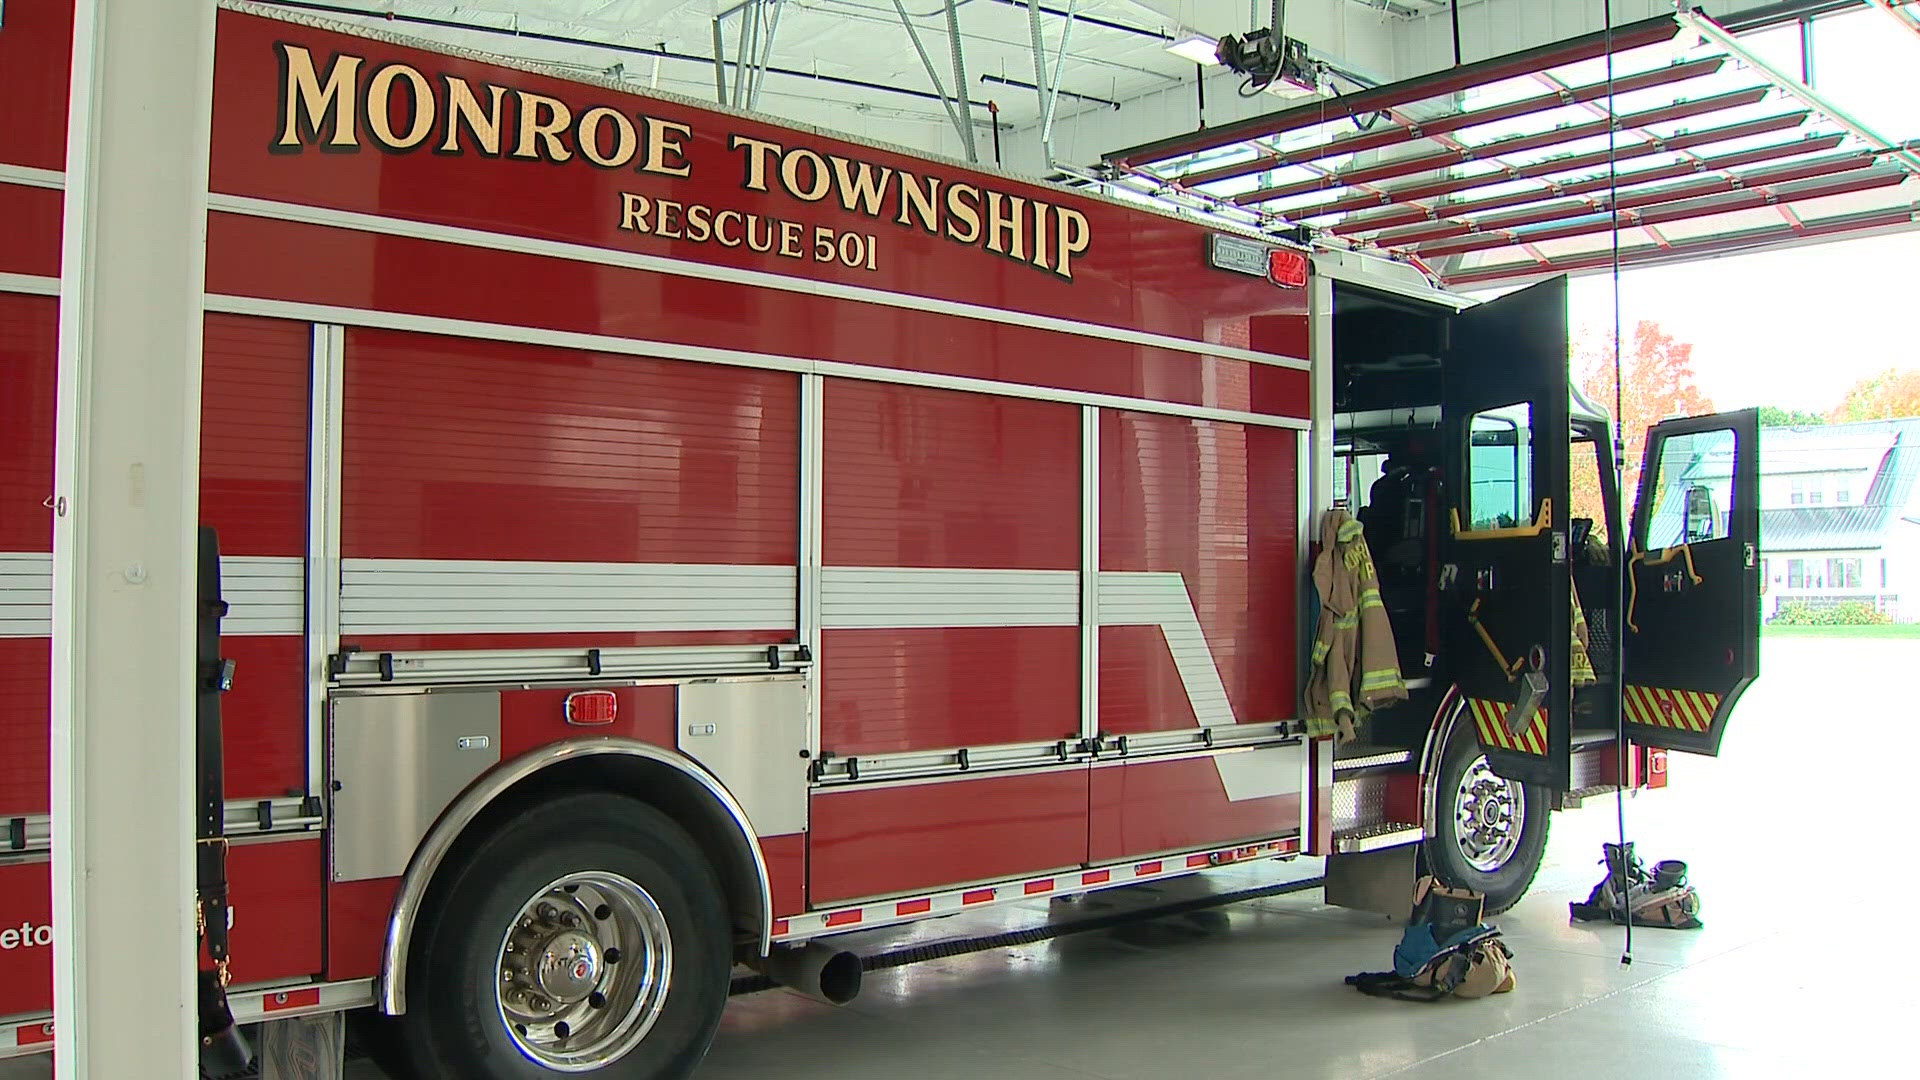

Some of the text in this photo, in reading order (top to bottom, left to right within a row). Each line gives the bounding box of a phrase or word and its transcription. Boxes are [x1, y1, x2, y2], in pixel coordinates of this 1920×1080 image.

[272, 42, 1091, 279] MONROE TOWNSHIP
[619, 191, 878, 271] RESCUE 501
